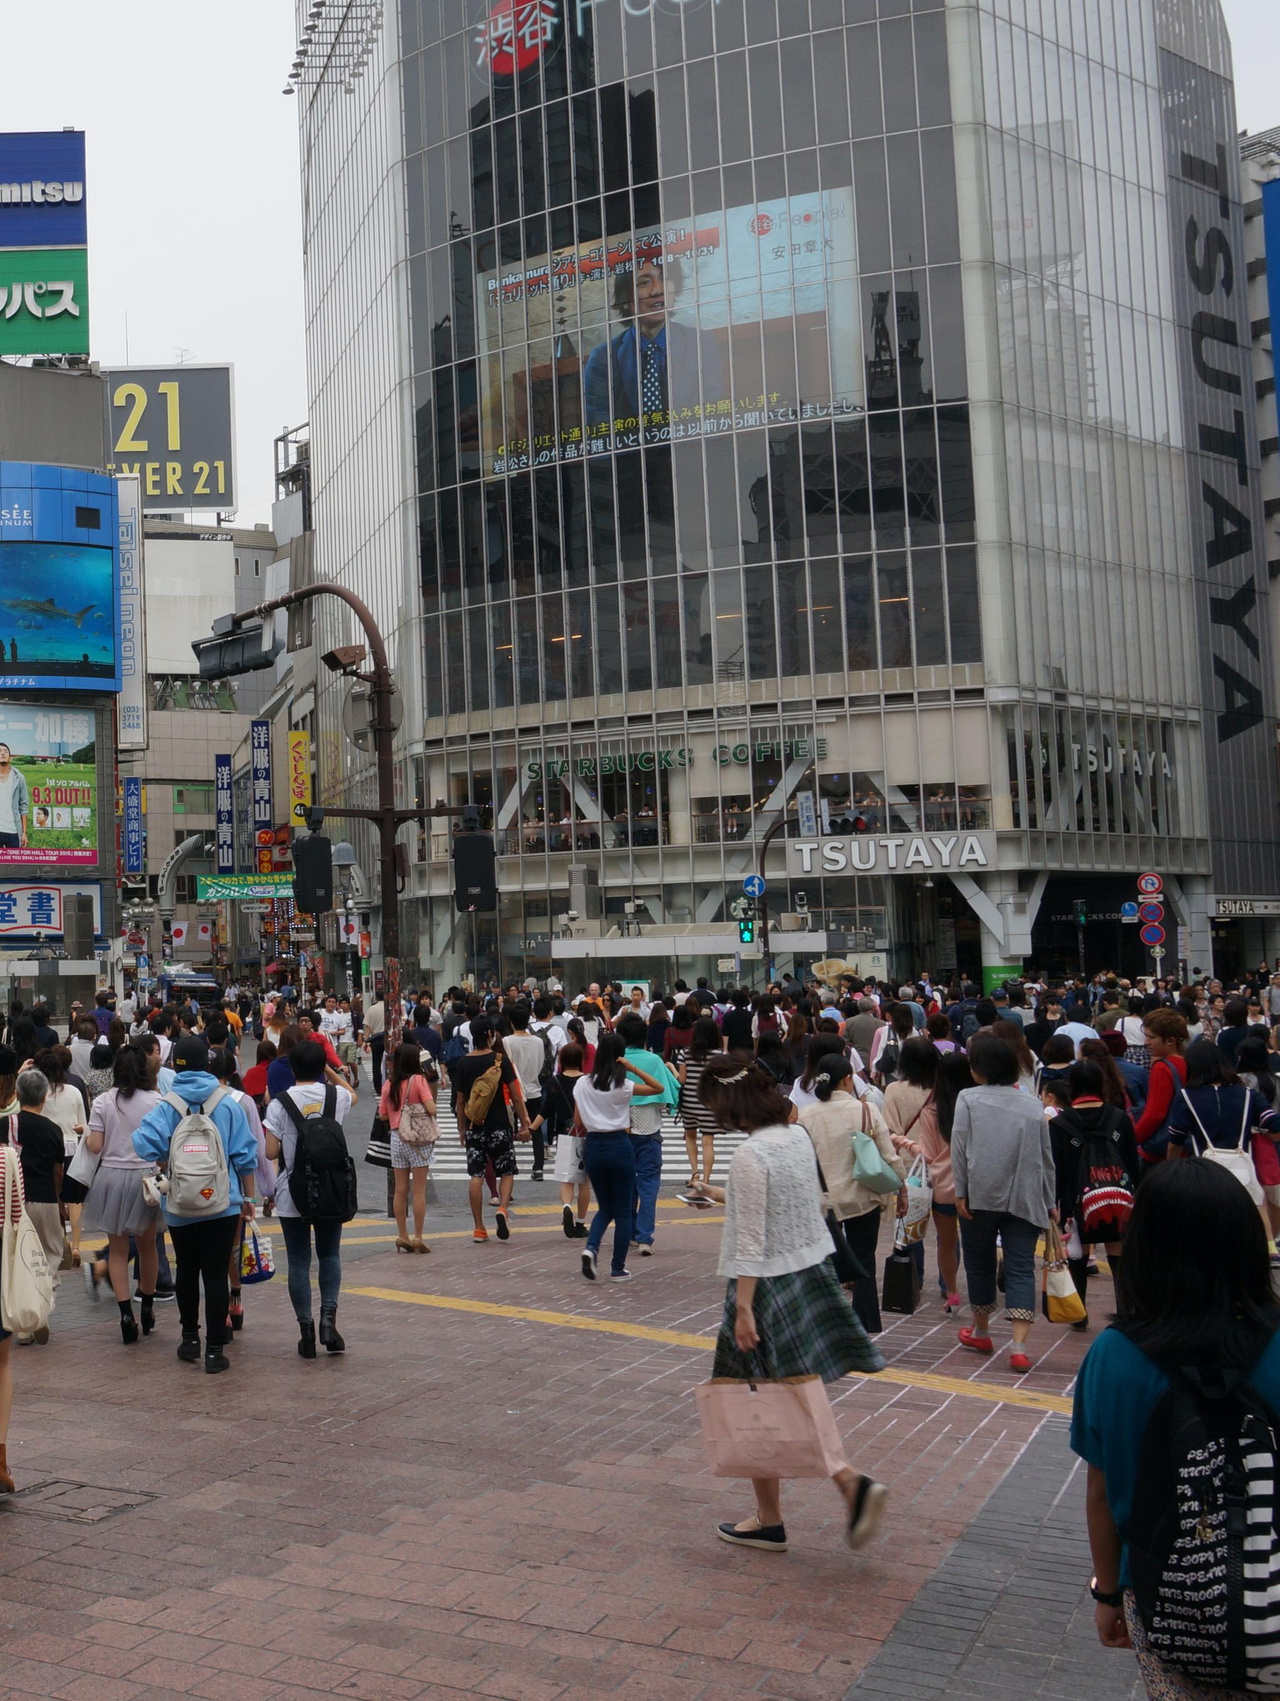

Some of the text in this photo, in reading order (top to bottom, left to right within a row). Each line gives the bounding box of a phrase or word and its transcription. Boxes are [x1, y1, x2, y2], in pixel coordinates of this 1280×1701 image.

[474, 1, 558, 66] 渋谷
[114, 381, 181, 452] 21
[1181, 142, 1265, 744] TSUTAYA
[194, 460, 225, 494] 21
[122, 714, 140, 722] 3719
[122, 722, 140, 730] 2468
[123, 706, 139, 714] (03)
[253, 726, 270, 821] 洋服の青山
[527, 738, 828, 782] STARBUCKS COFFEE
[1071, 743, 1172, 778] TSUTAYA
[32, 786, 91, 806] 9.3 OUT!!
[47, 778, 55, 786] 1st
[69, 779, 90, 787] アルバム
[127, 783, 140, 867] 大盛堂商事ビル
[217, 766, 233, 867] 洋服の青山
[794, 836, 988, 872] TSUTAYA
[1051, 913, 1104, 921] STARCKS
[1217, 902, 1255, 914] TSUTAYA
[1164, 1602, 1202, 1620] SNOOPY
[1174, 1635, 1220, 1651] SNOOPY
